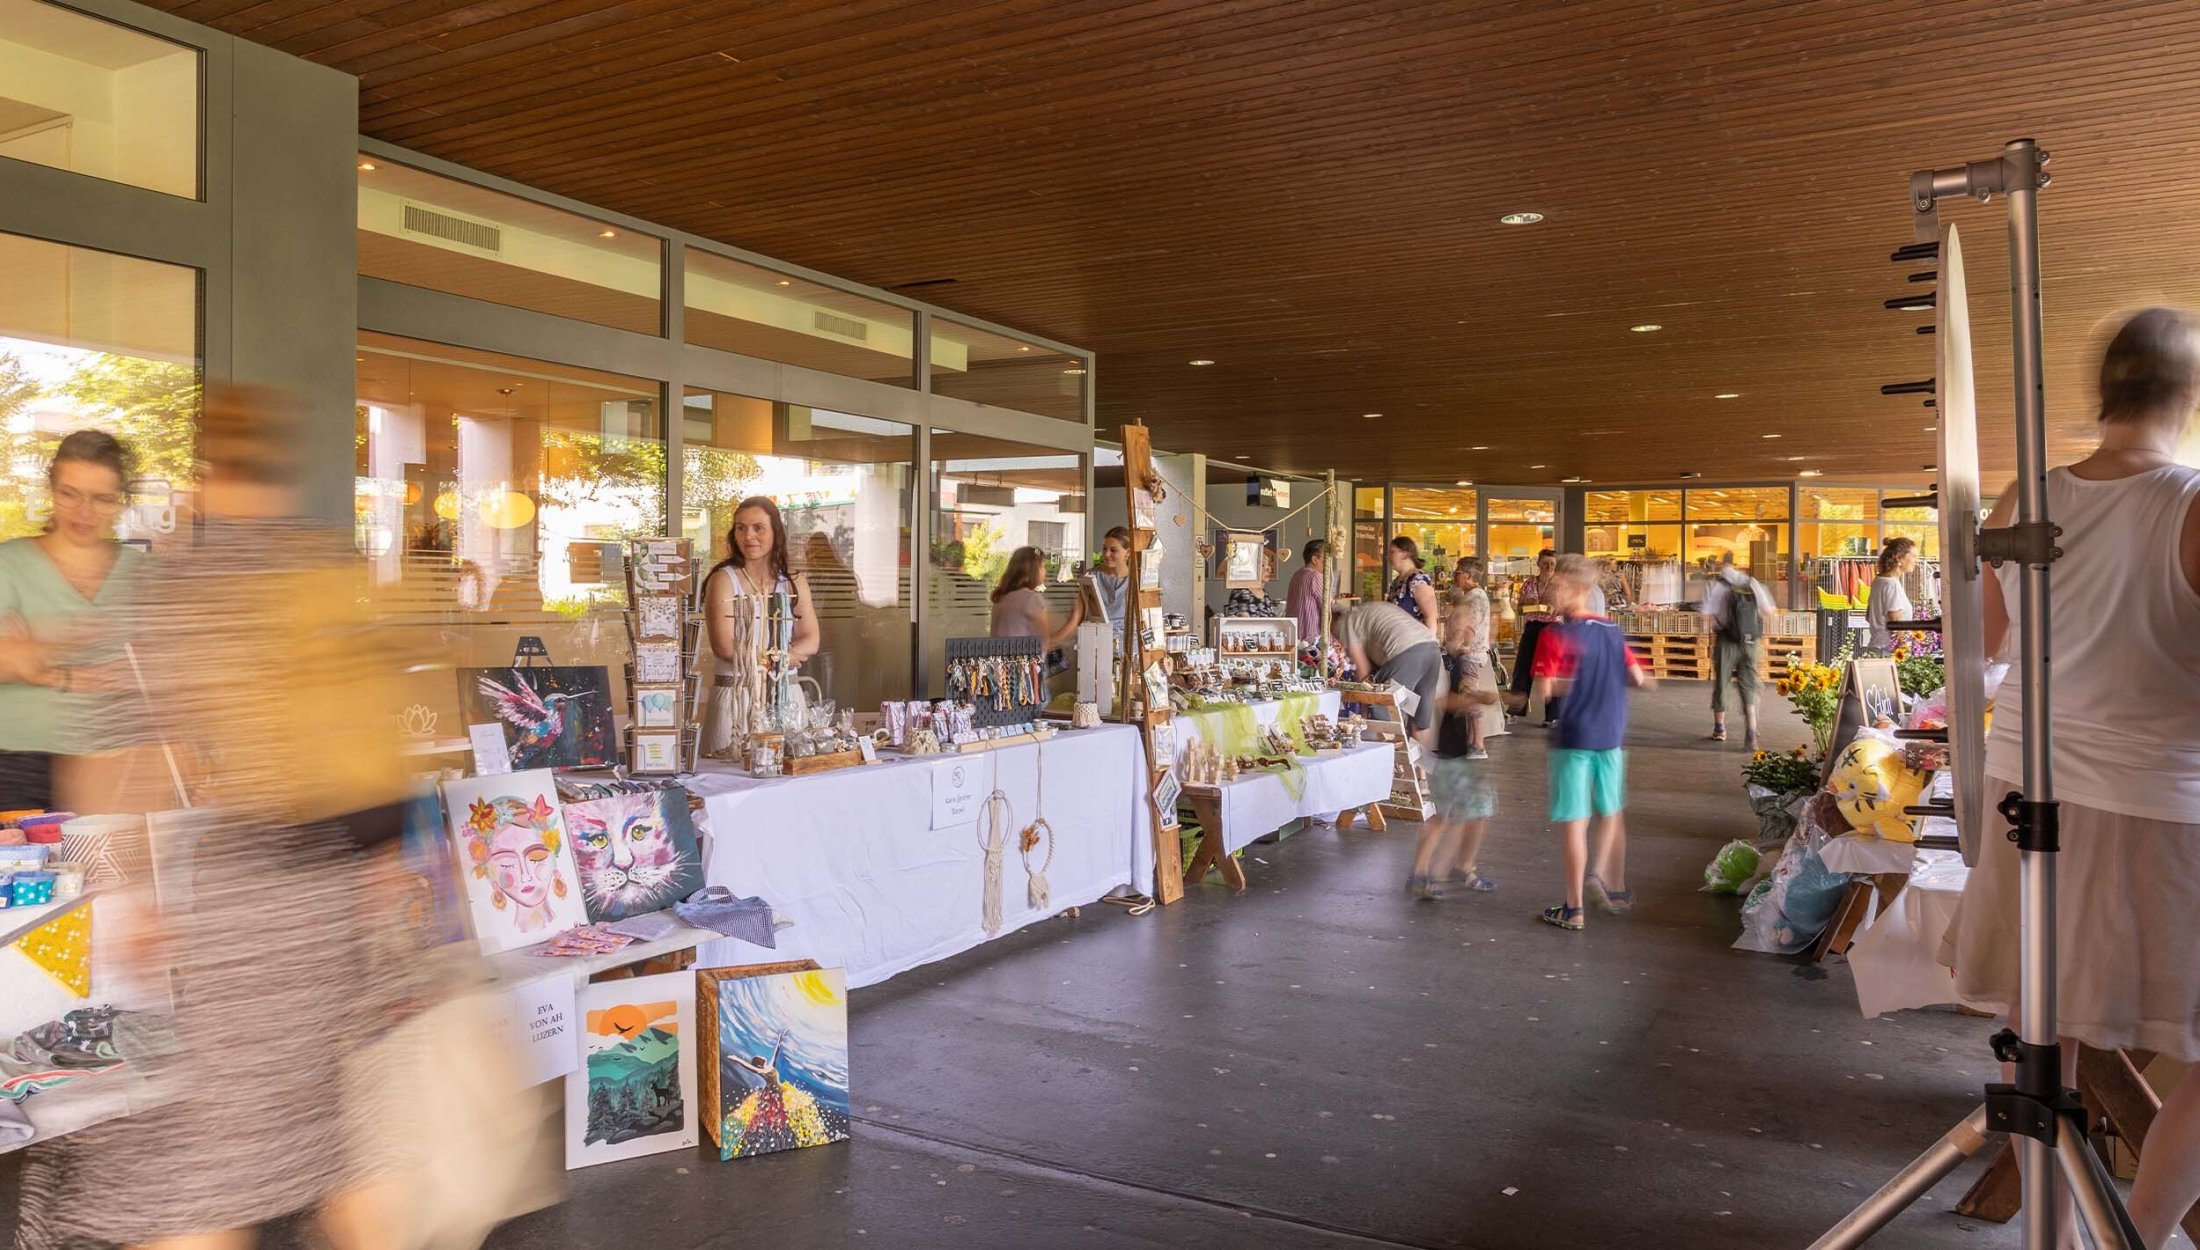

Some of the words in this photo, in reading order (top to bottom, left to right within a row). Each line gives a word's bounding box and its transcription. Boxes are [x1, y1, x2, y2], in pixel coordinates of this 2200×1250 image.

[537, 1003, 554, 1015] EVA
[529, 1016, 549, 1031] VON
[550, 1011, 563, 1024] AH
[532, 1024, 565, 1043] LUZERN
